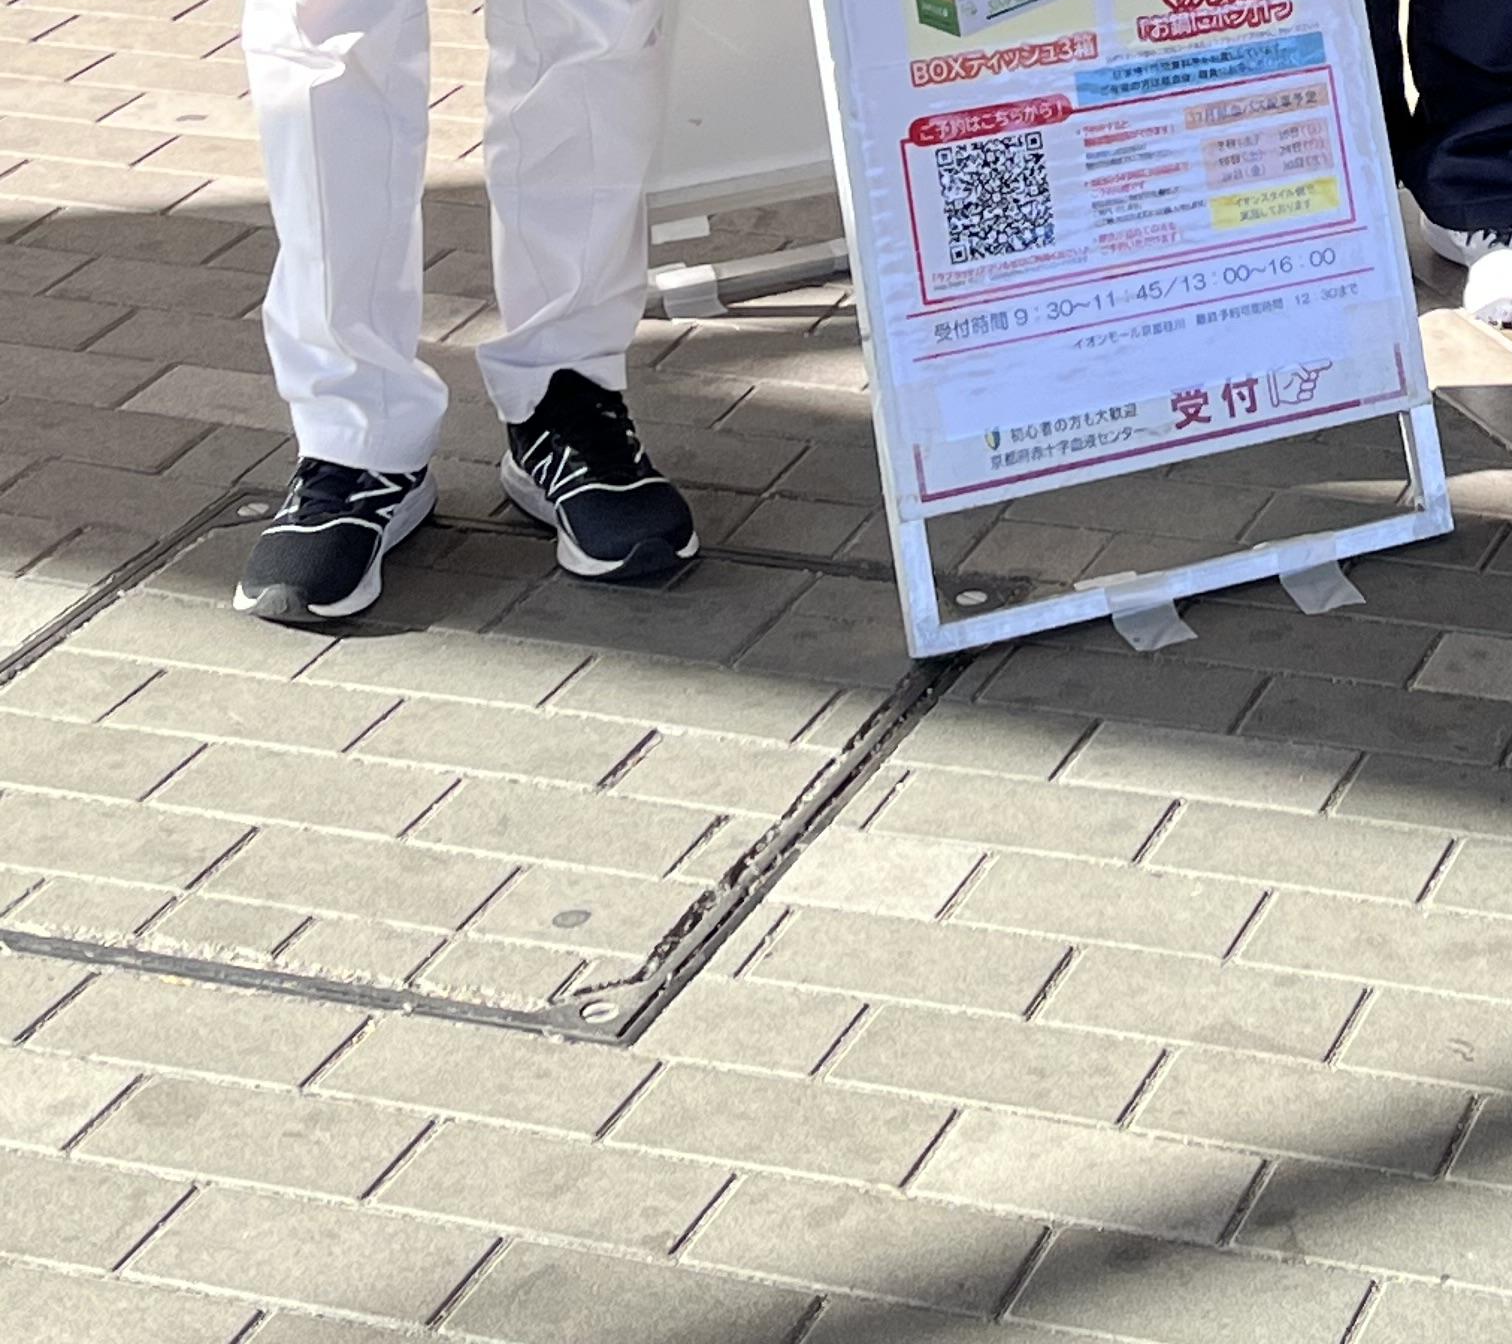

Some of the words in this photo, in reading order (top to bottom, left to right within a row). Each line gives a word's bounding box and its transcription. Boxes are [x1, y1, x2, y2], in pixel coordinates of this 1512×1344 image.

[910, 31, 1099, 88] BOXティッシュ3箱
[933, 312, 1009, 345] 受付時間
[1010, 402, 1138, 444] 初心者の方も大歓迎
[1170, 376, 1259, 430] 受付
